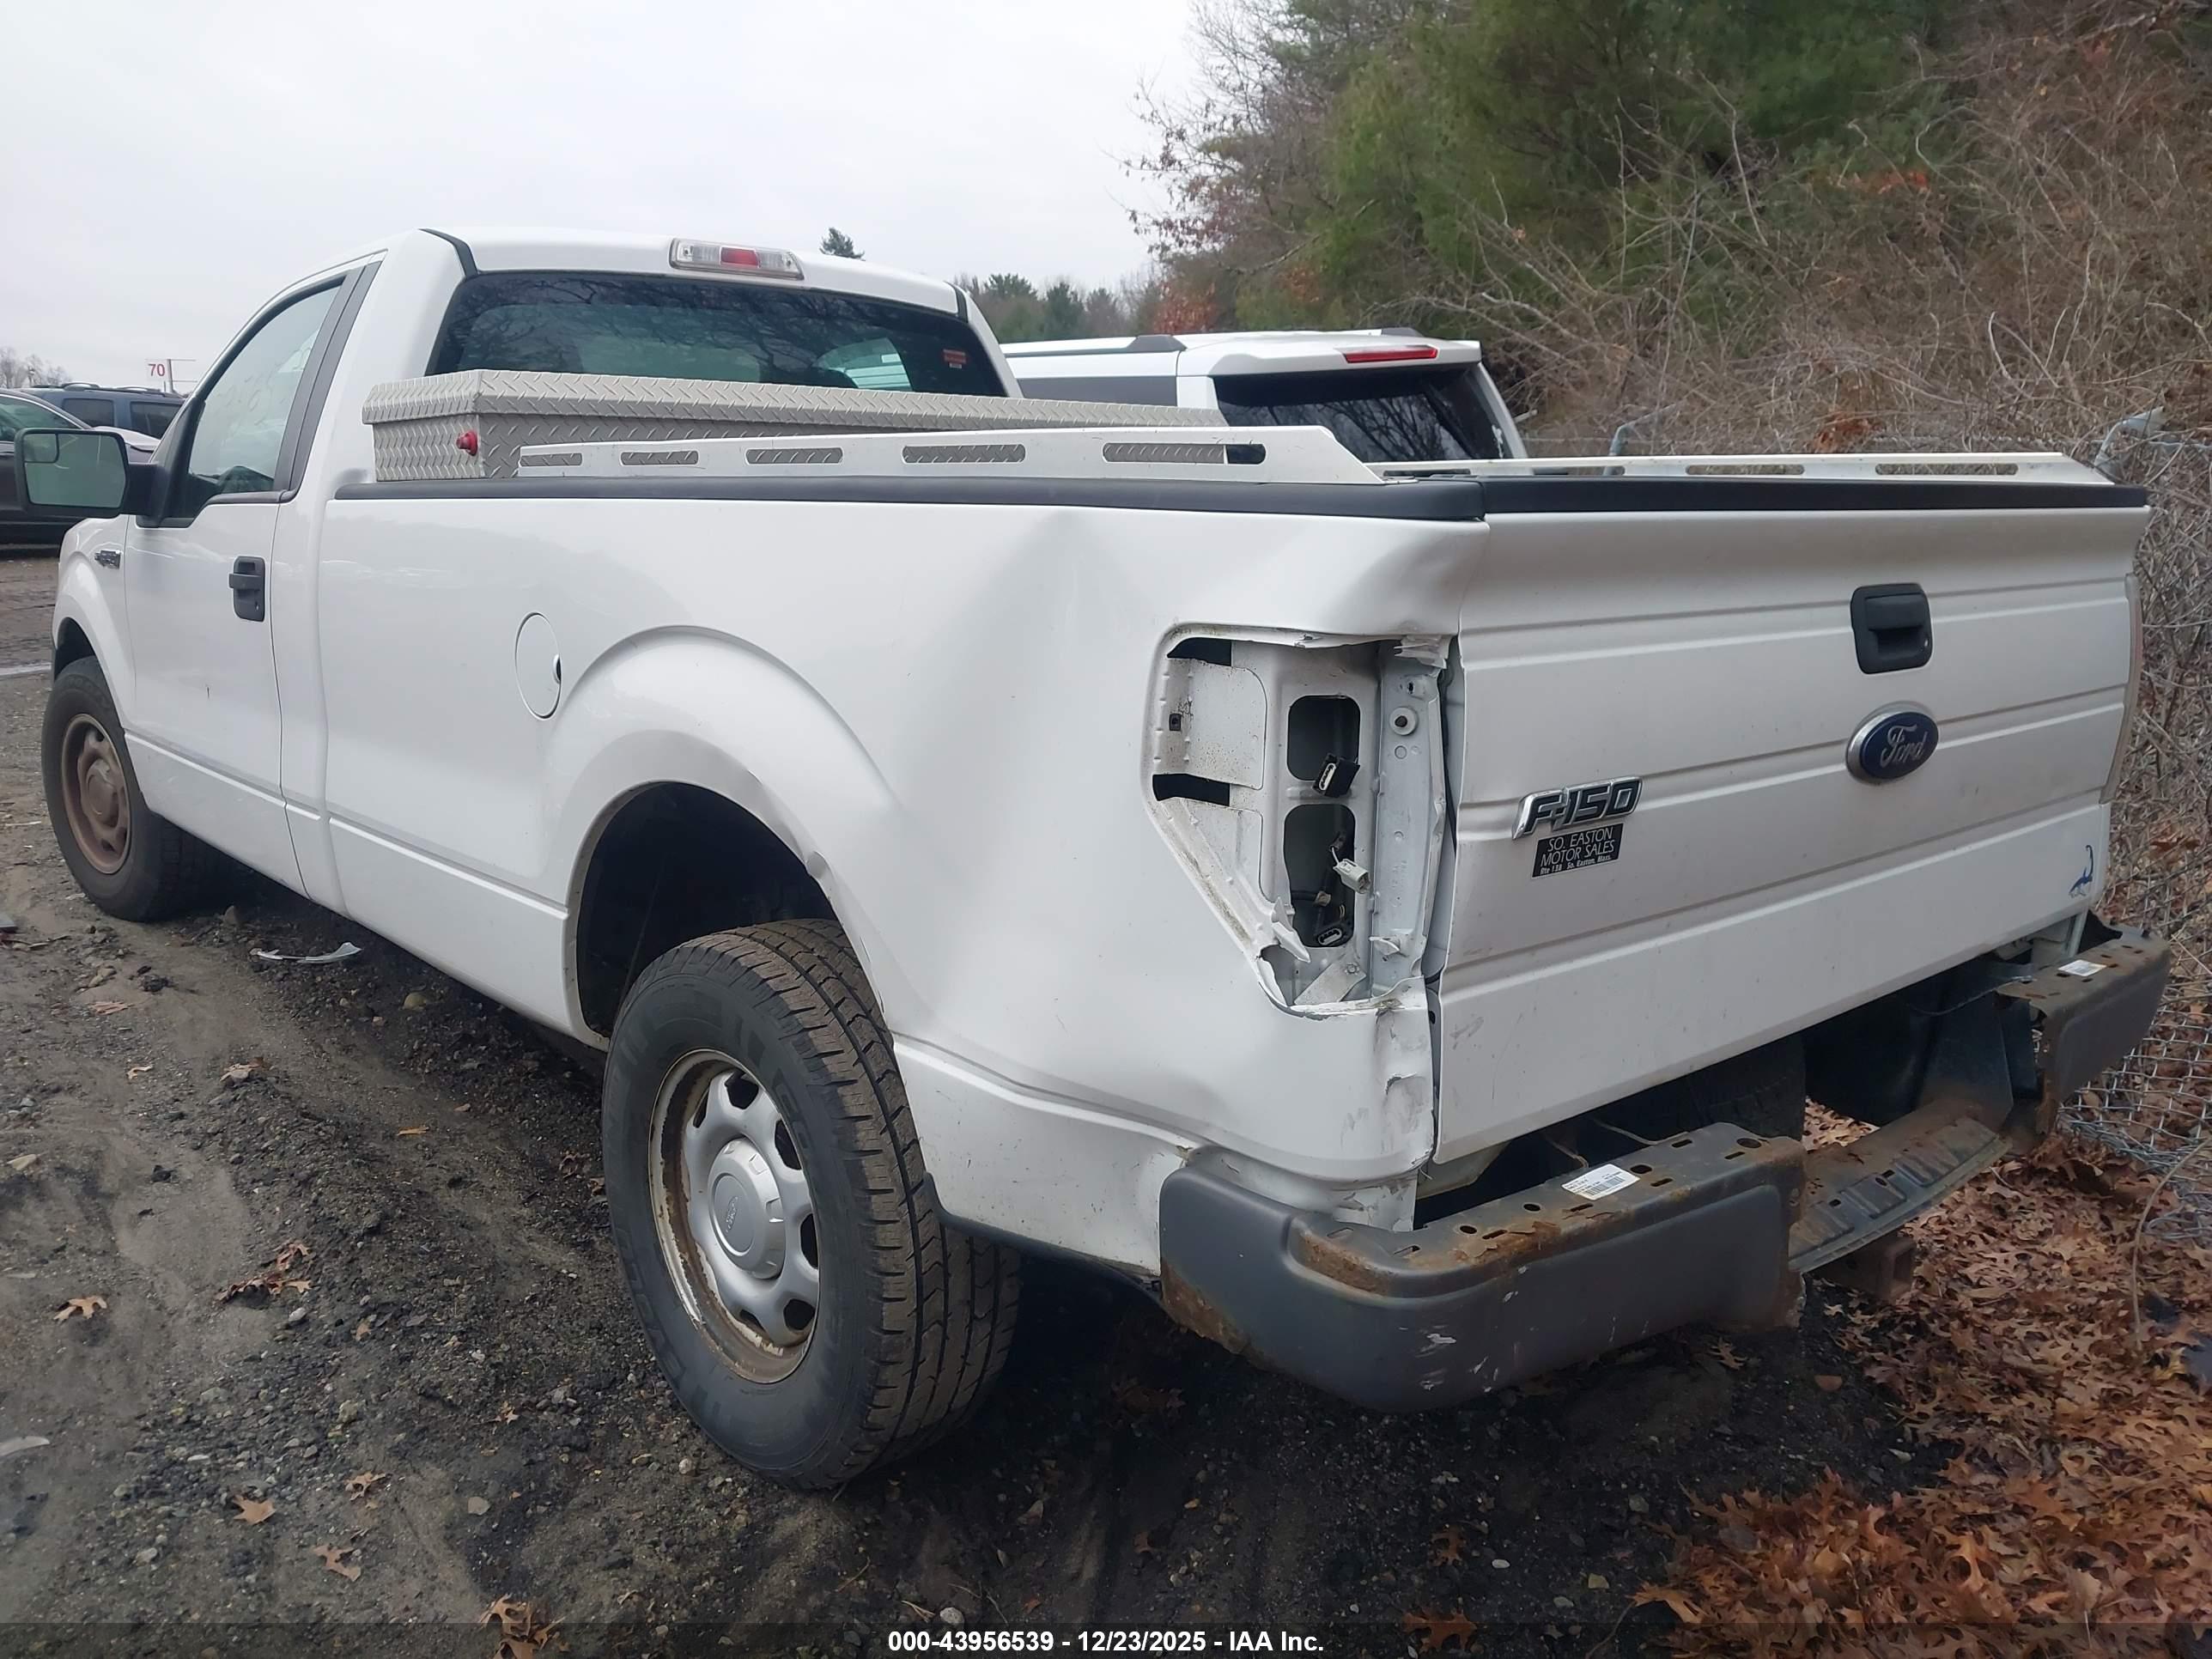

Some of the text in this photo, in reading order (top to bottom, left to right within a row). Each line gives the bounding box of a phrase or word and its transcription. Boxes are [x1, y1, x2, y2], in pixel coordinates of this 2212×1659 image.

[148, 363, 165, 377] 70
[1880, 724, 1929, 769] Ford
[1514, 777, 1644, 838] F-150
[1540, 839, 1615, 867] MOTOR SALES
[1547, 827, 1613, 852] SO. EASTON
